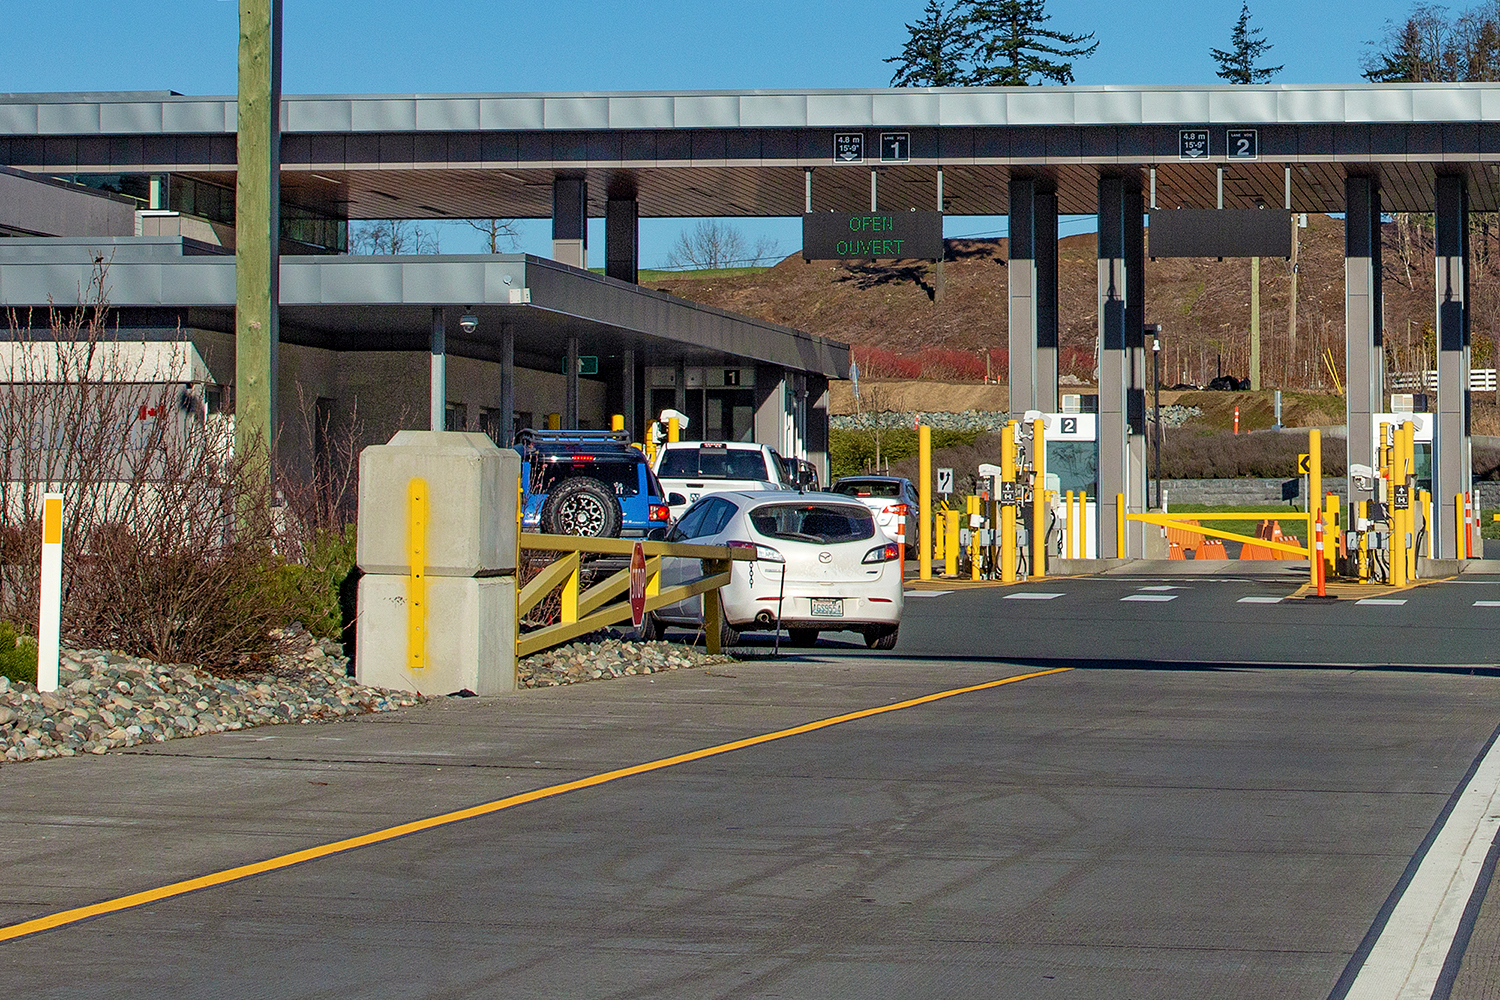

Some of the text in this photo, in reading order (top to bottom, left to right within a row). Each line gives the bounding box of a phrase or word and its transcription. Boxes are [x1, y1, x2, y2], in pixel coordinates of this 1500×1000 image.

[890, 141, 900, 159] 1
[1236, 138, 1250, 156] 2
[849, 216, 893, 232] OPEN
[836, 240, 905, 255] OUVERT
[729, 371, 736, 384] 1
[1064, 419, 1075, 432] 2
[631, 568, 645, 599] STOP
